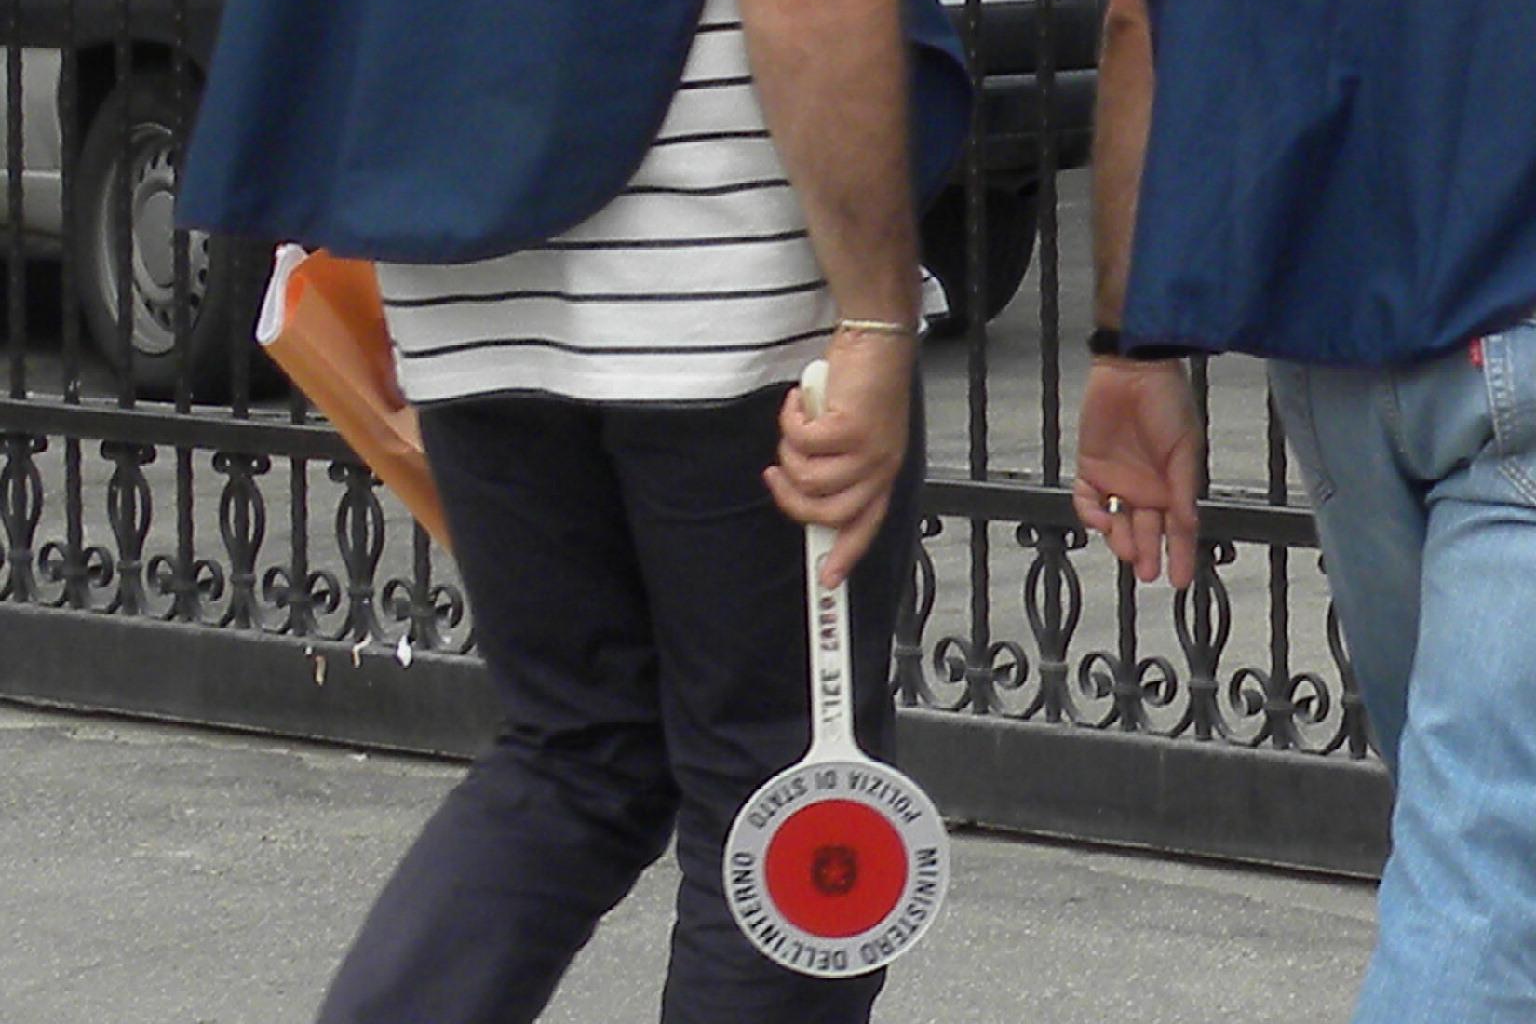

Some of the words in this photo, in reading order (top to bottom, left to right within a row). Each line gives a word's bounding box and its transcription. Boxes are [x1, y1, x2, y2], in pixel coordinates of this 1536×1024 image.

[749, 777, 808, 830] STATO
[814, 769, 838, 790] DI
[847, 769, 923, 825] POLIZIA
[731, 851, 848, 971] DELL'INTERNO
[858, 846, 940, 965] MINISTERO
